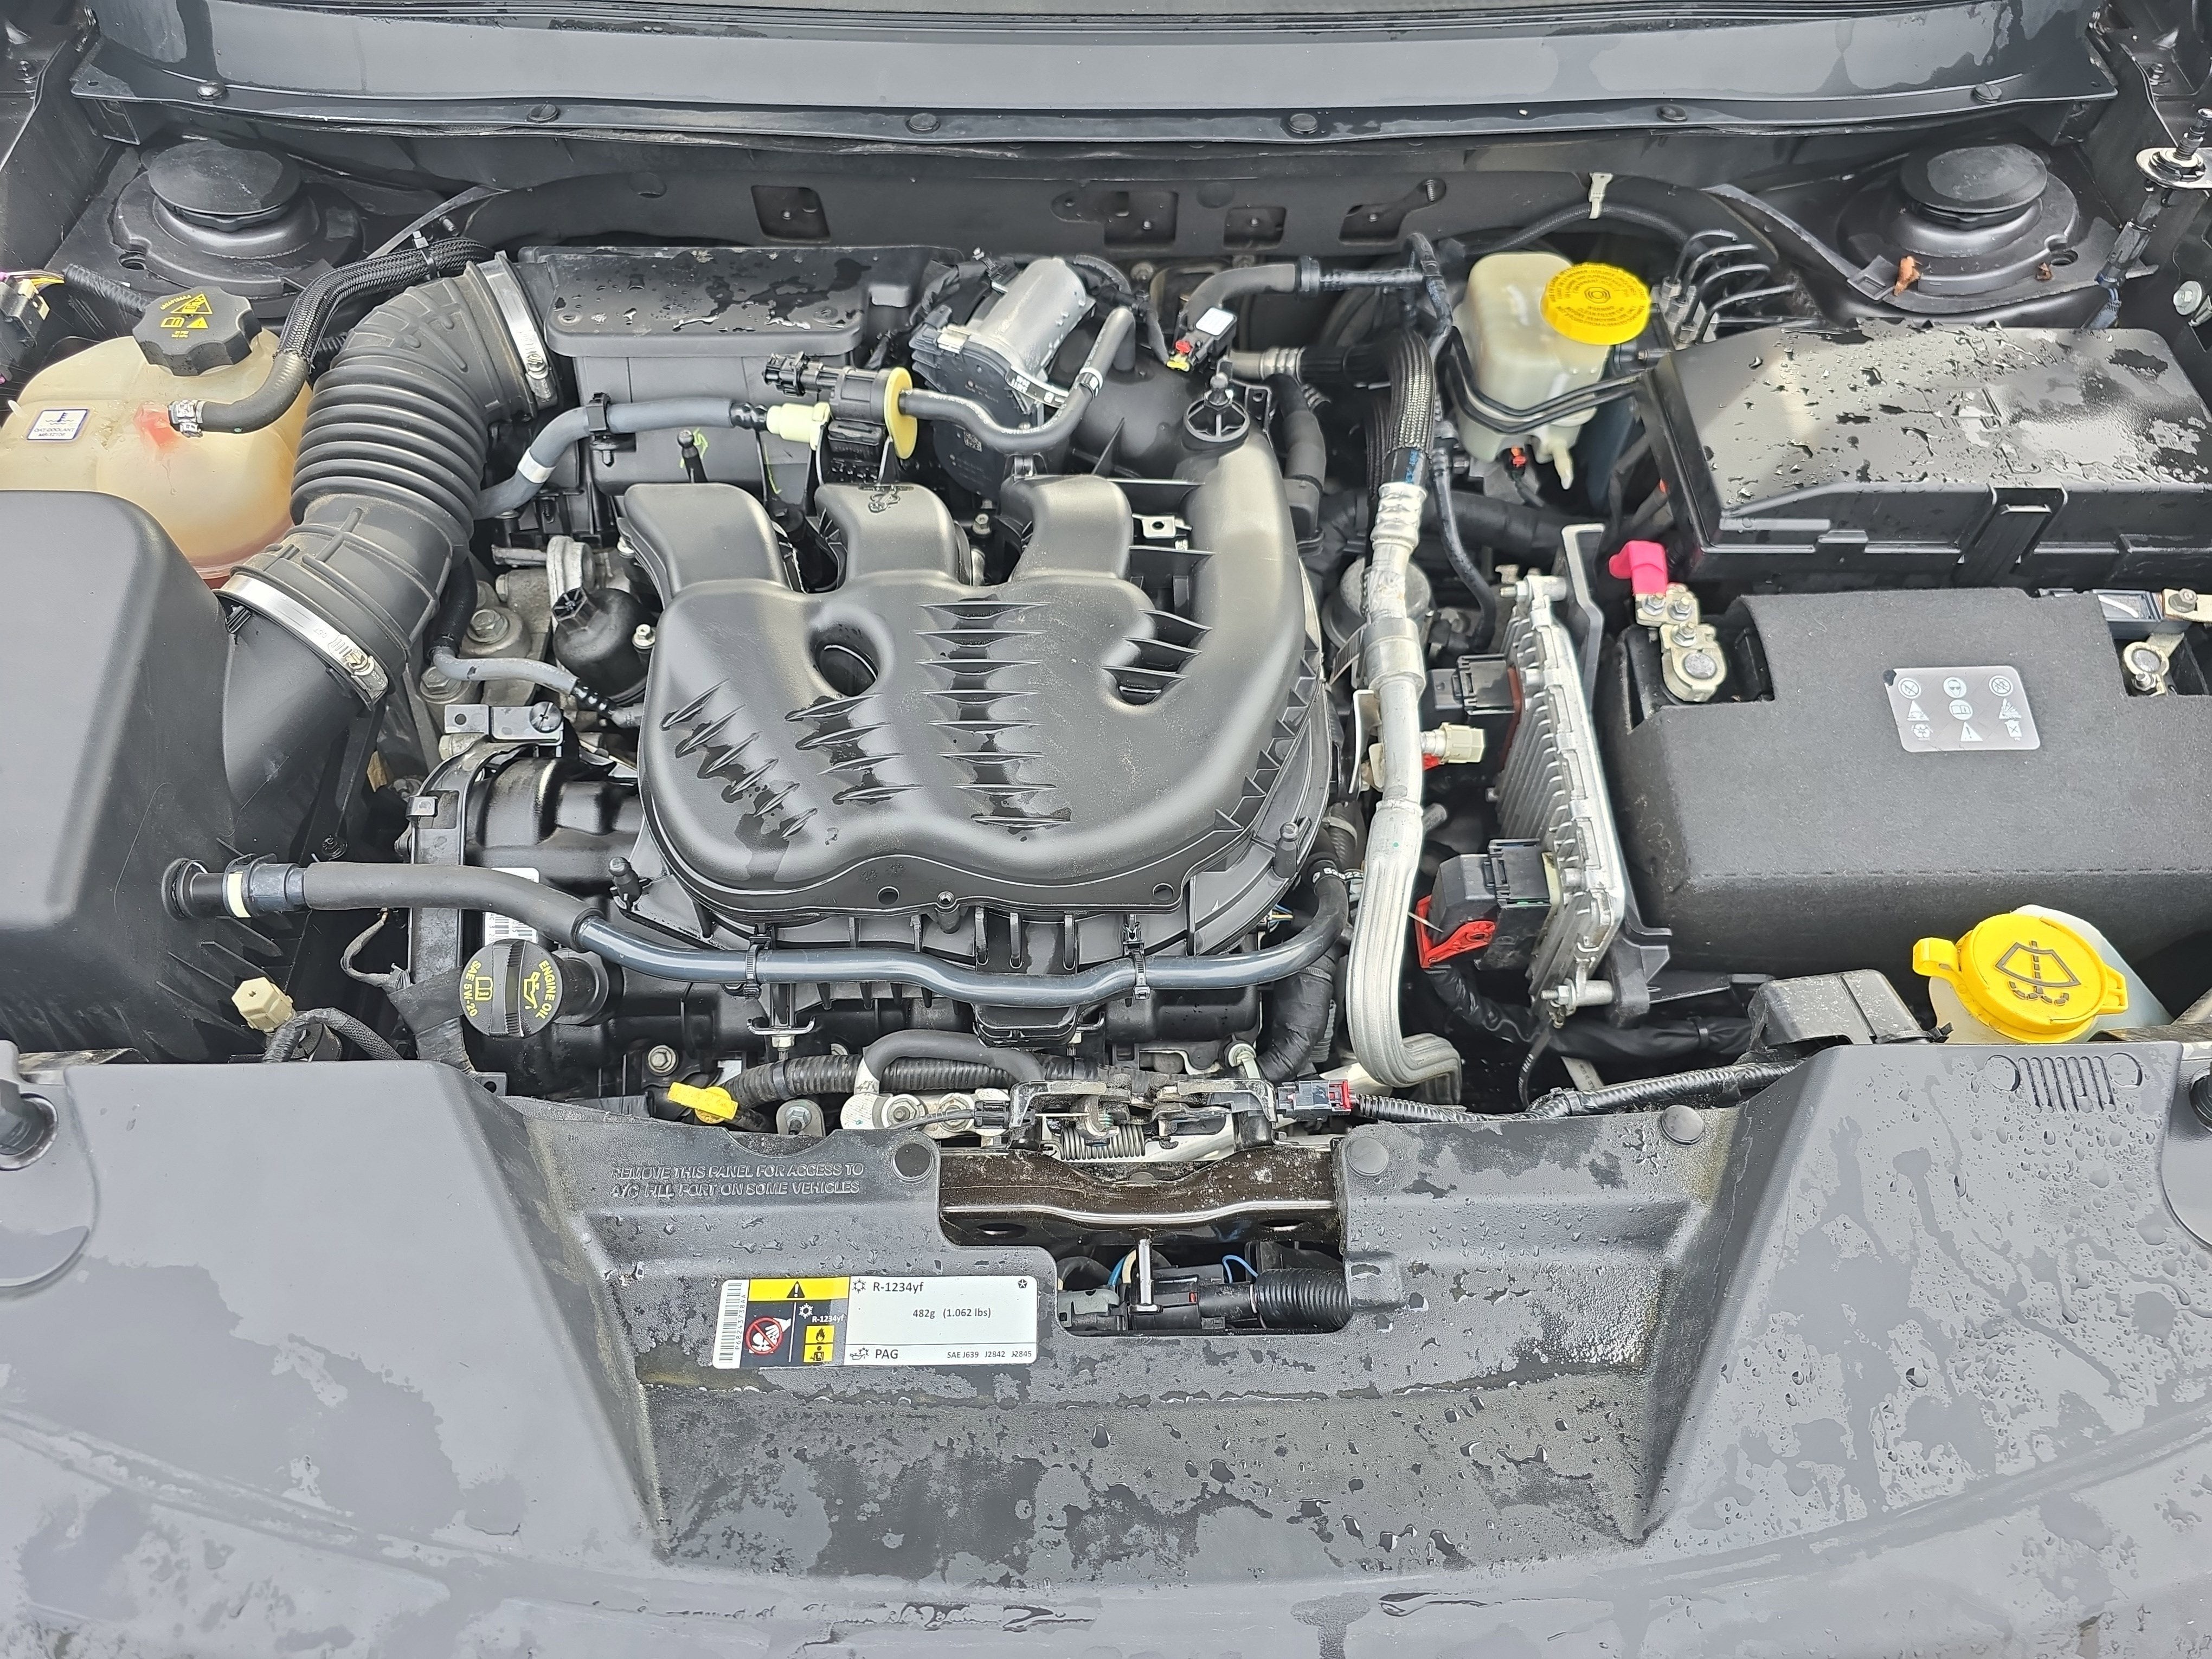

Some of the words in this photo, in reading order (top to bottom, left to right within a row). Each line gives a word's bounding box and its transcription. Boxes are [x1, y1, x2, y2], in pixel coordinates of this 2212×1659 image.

[465, 960, 481, 981] SAE
[538, 960, 557, 1001] ENGINE
[463, 983, 478, 1017] 5W-20
[535, 1002, 552, 1019] OIL
[612, 1166, 670, 1180] REMOVE
[673, 1166, 706, 1179] THIS
[709, 1165, 754, 1179] PANEL
[756, 1165, 785, 1178] FOR
[787, 1163, 843, 1176] ACCESS
[844, 1163, 865, 1176] TO
[610, 1184, 640, 1198] A/C
[644, 1184, 674, 1198] FILL
[678, 1183, 718, 1197] PORT
[721, 1182, 743, 1195] ON
[745, 1182, 787, 1195] SOME
[790, 1180, 860, 1194] VEHICLES
[873, 1281, 924, 1294] R-1234yf
[812, 1314, 845, 1324] R-1234yf
[912, 1309, 935, 1320] 482g
[943, 1307, 972, 1319] (1.062
[974, 1307, 992, 1318] lbs)
[734, 1294, 747, 1351] P68243738AA
[875, 1348, 898, 1360] PAG
[1011, 1350, 1032, 1358] J2845
